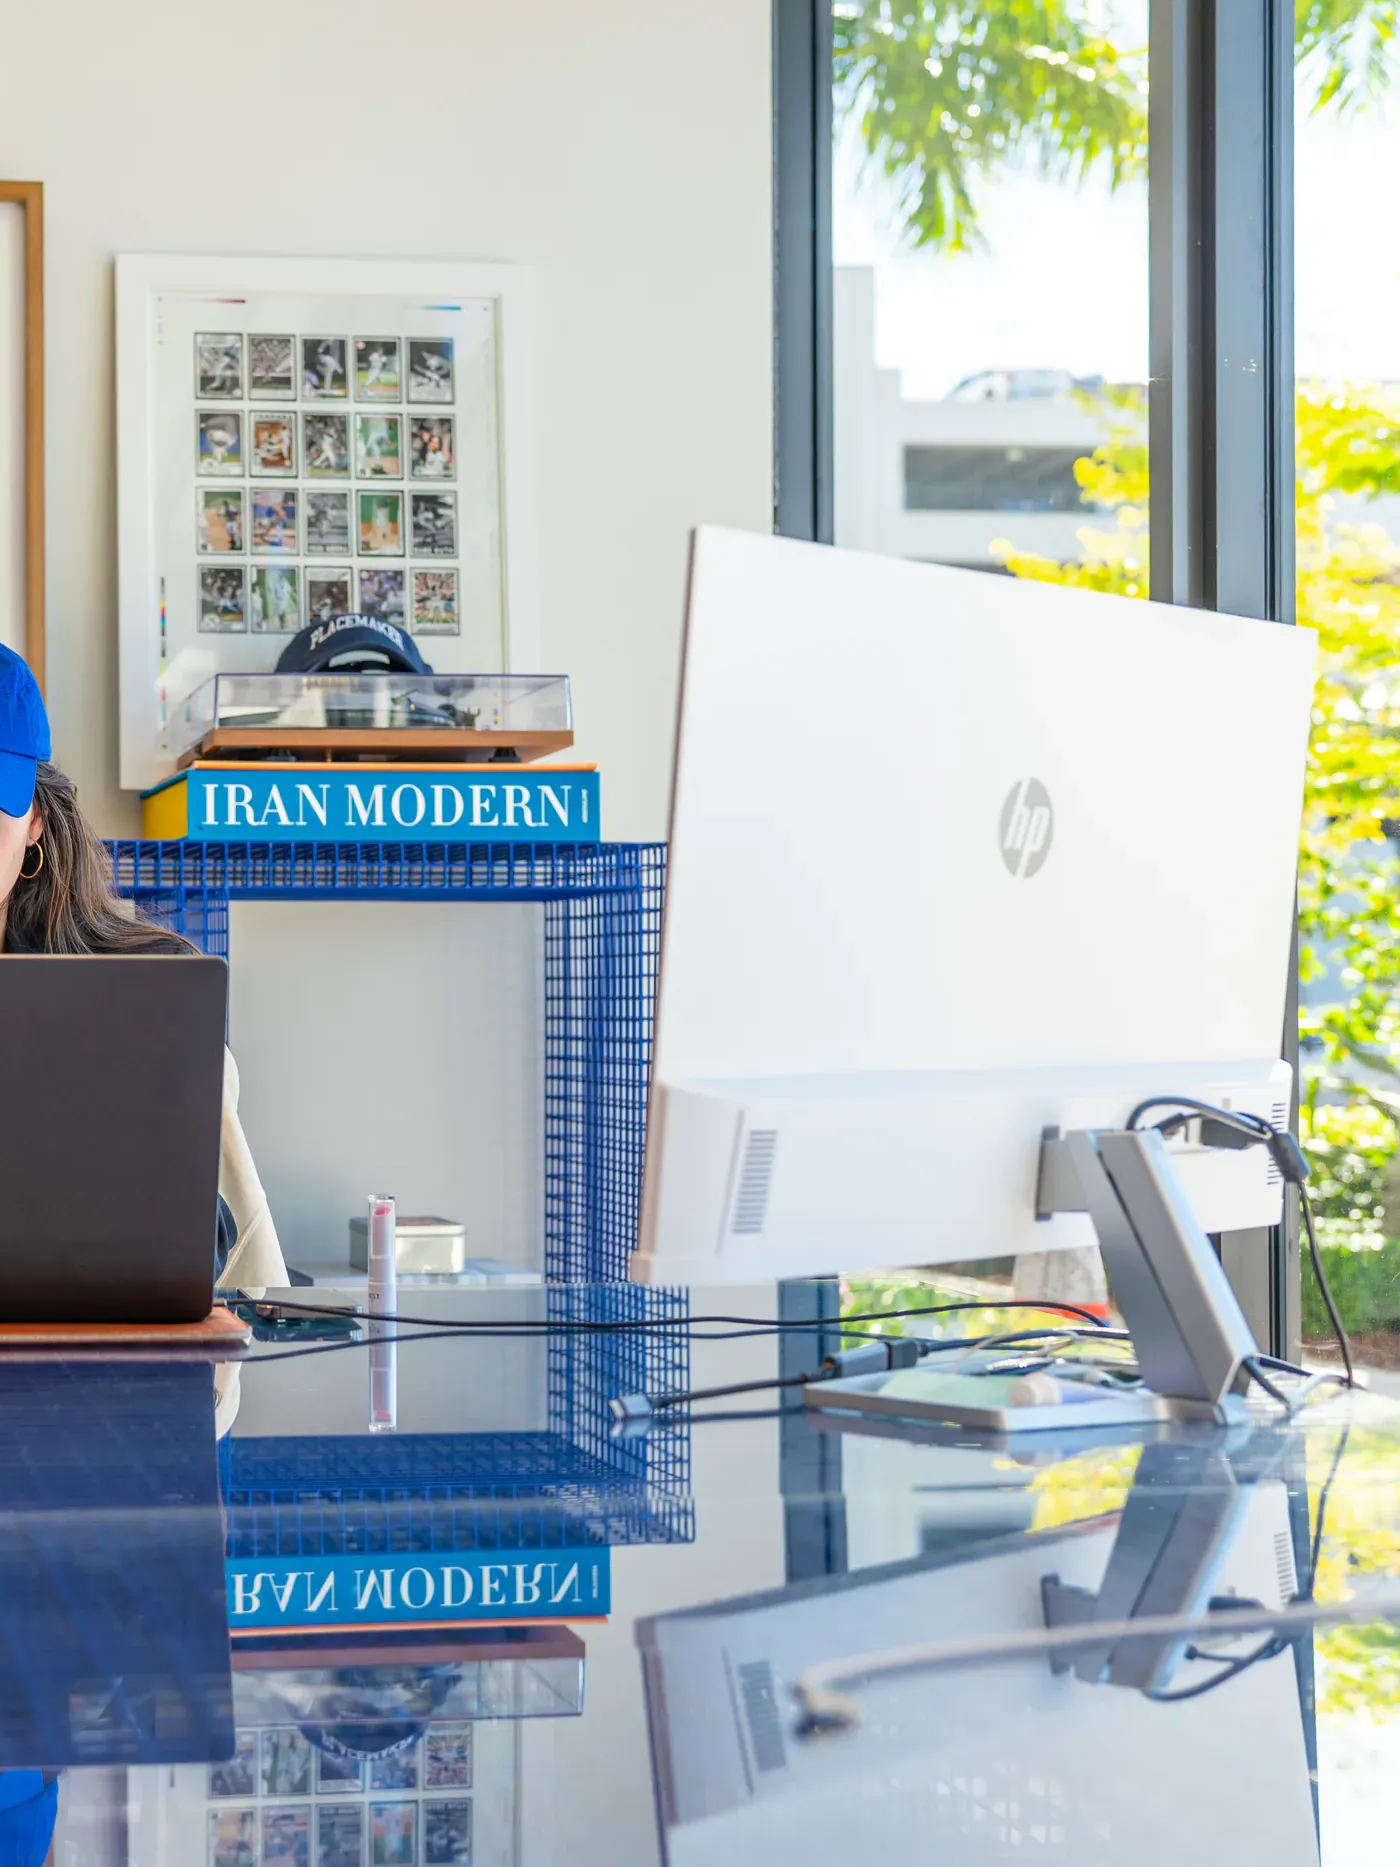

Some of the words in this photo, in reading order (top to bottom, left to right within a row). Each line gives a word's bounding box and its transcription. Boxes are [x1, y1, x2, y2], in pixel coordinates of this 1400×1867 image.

[309, 614, 405, 651] PLACEMAKER
[201, 783, 331, 826] IRAN
[343, 784, 572, 827] MODERN
